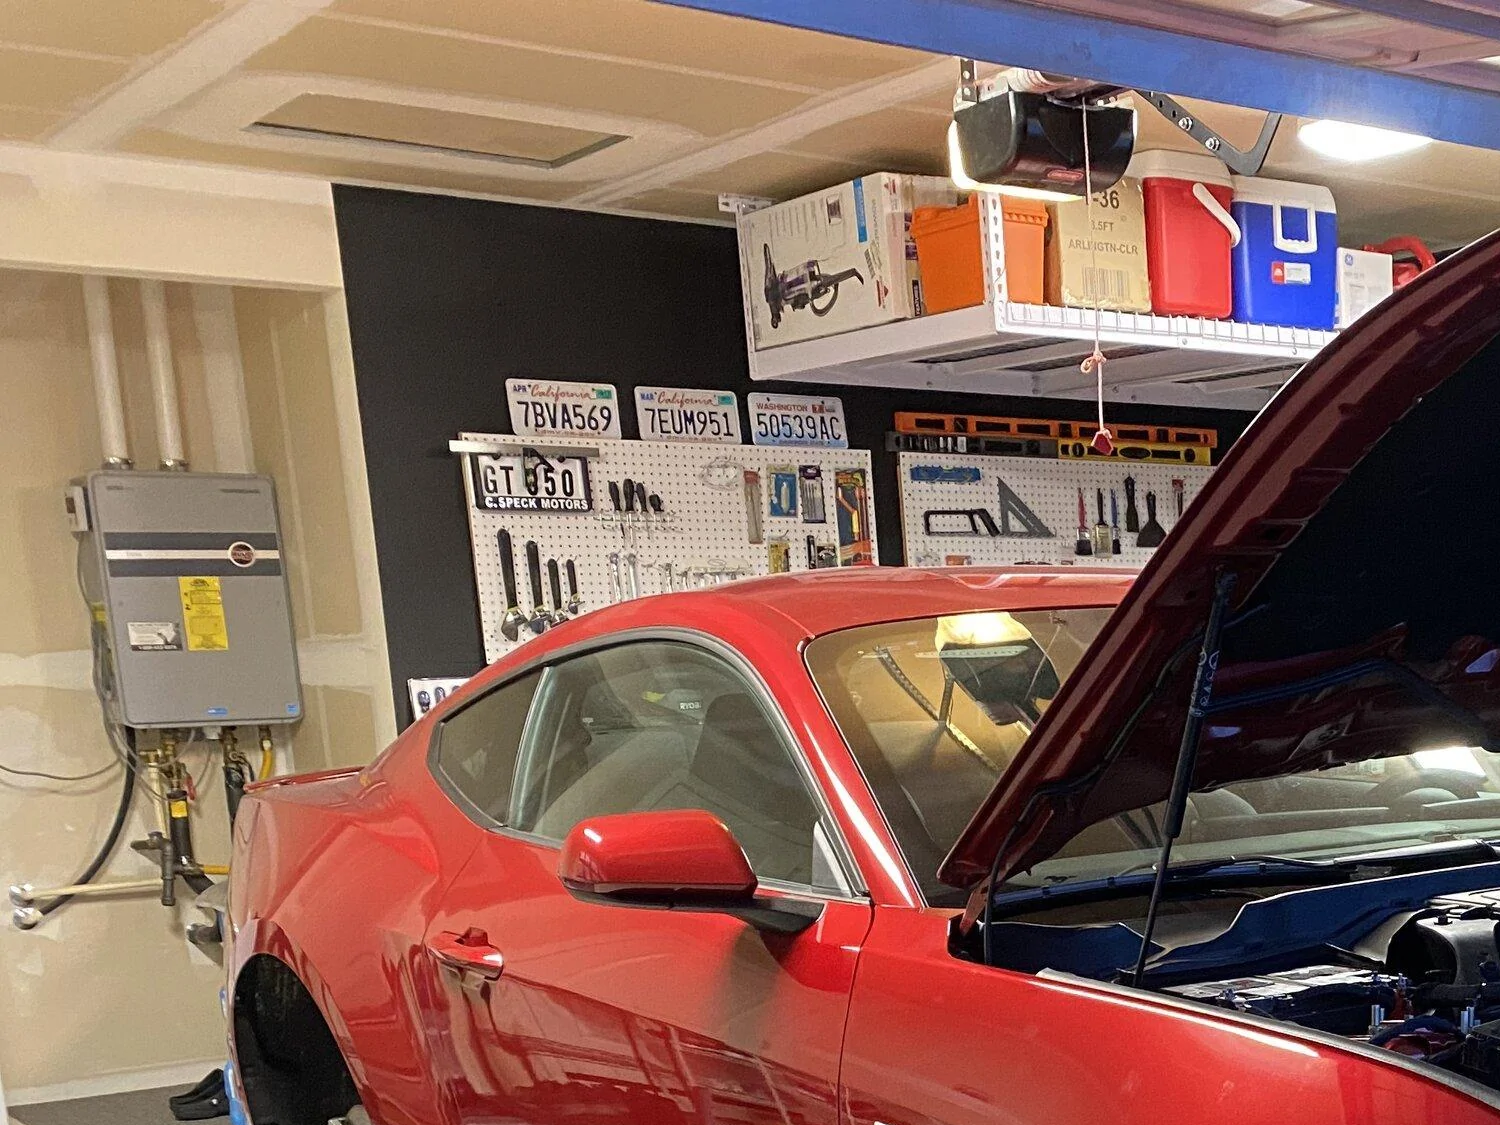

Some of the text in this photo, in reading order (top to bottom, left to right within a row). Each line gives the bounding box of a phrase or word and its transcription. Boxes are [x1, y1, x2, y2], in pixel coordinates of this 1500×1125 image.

[530, 383, 593, 402] California
[657, 391, 715, 408] California
[516, 400, 612, 432] 7BVA569
[756, 402, 808, 412] WASHINGTON
[644, 407, 734, 437] 7EUM951
[756, 412, 841, 440] 50539AC
[483, 465, 514, 495] GT
[541, 498, 589, 510] MOTORS
